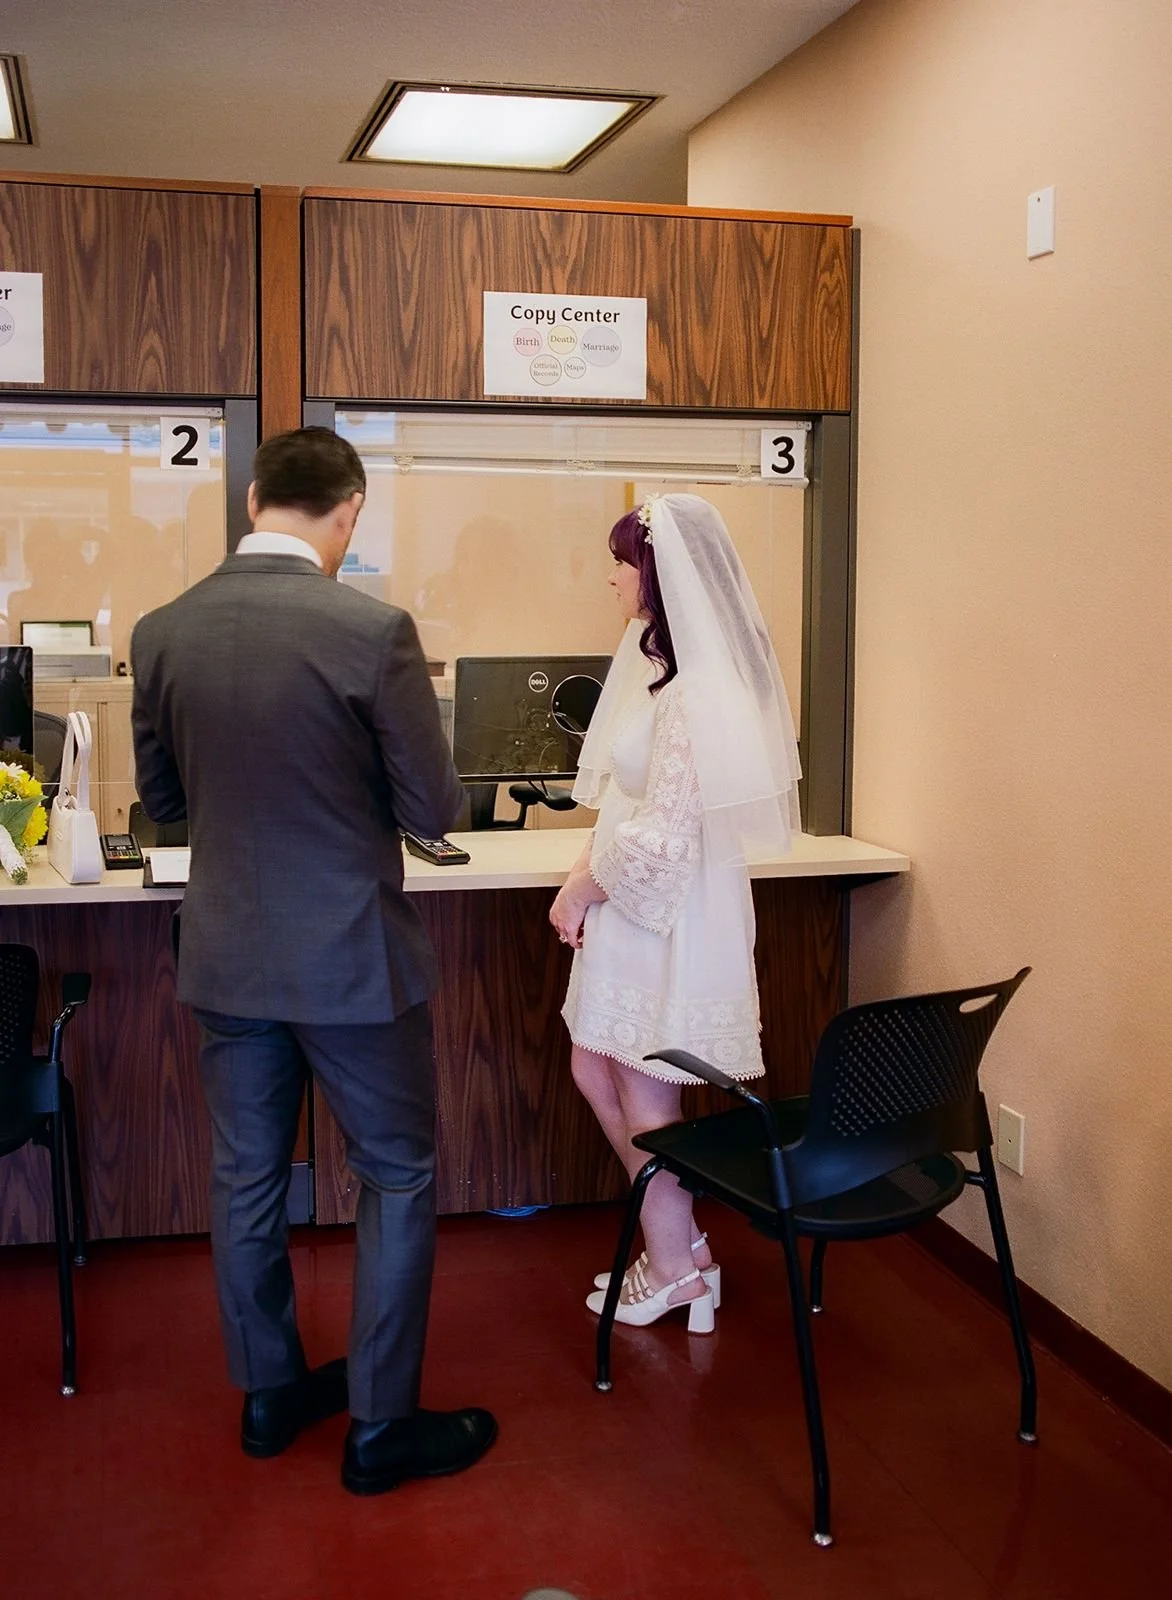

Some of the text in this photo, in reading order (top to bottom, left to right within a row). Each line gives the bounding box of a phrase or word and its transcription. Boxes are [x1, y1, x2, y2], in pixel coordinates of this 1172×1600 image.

[510, 305, 620, 325] Copy Center
[516, 337, 540, 346] Birth
[550, 335, 575, 344] Death
[583, 343, 619, 352] Marriage
[566, 364, 584, 372] Maps
[171, 425, 198, 466] 2
[771, 436, 795, 474] 3
